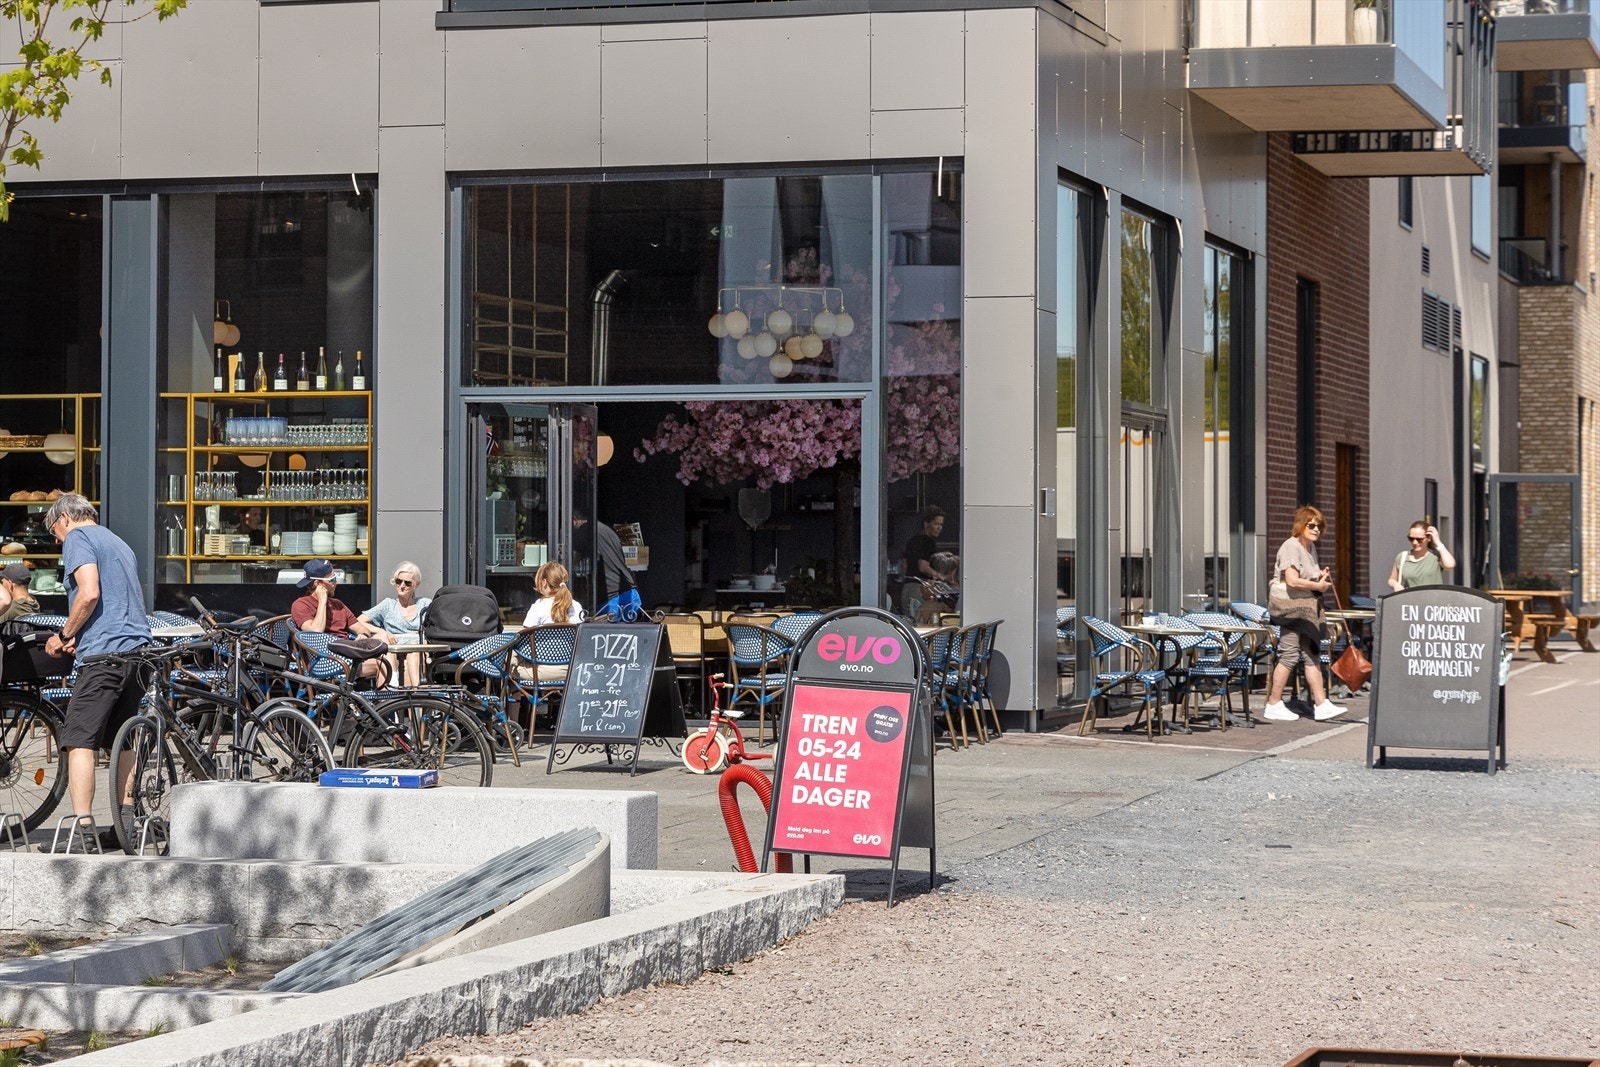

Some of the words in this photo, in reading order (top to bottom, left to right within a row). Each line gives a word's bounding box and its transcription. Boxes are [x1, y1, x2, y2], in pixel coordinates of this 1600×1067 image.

[1401, 604, 1419, 621] EN
[1424, 604, 1482, 623] CROISSANT
[1409, 623, 1425, 640] OM
[1428, 624, 1465, 641] DAGEN
[591, 634, 638, 661] PIZZA
[817, 633, 901, 664] evo
[1401, 641, 1421, 657] GIR
[1425, 642, 1451, 658] DEN
[1455, 643, 1485, 660] SEXY
[839, 663, 874, 673] evo.no
[1408, 659, 1472, 677] PAPPAMAGEN
[607, 687, 621, 695] fre
[801, 713, 857, 736] TREN
[797, 737, 861, 761] 05-24
[793, 761, 847, 783] ALLE
[791, 785, 872, 810] DAGER
[852, 833, 882, 846] evo
